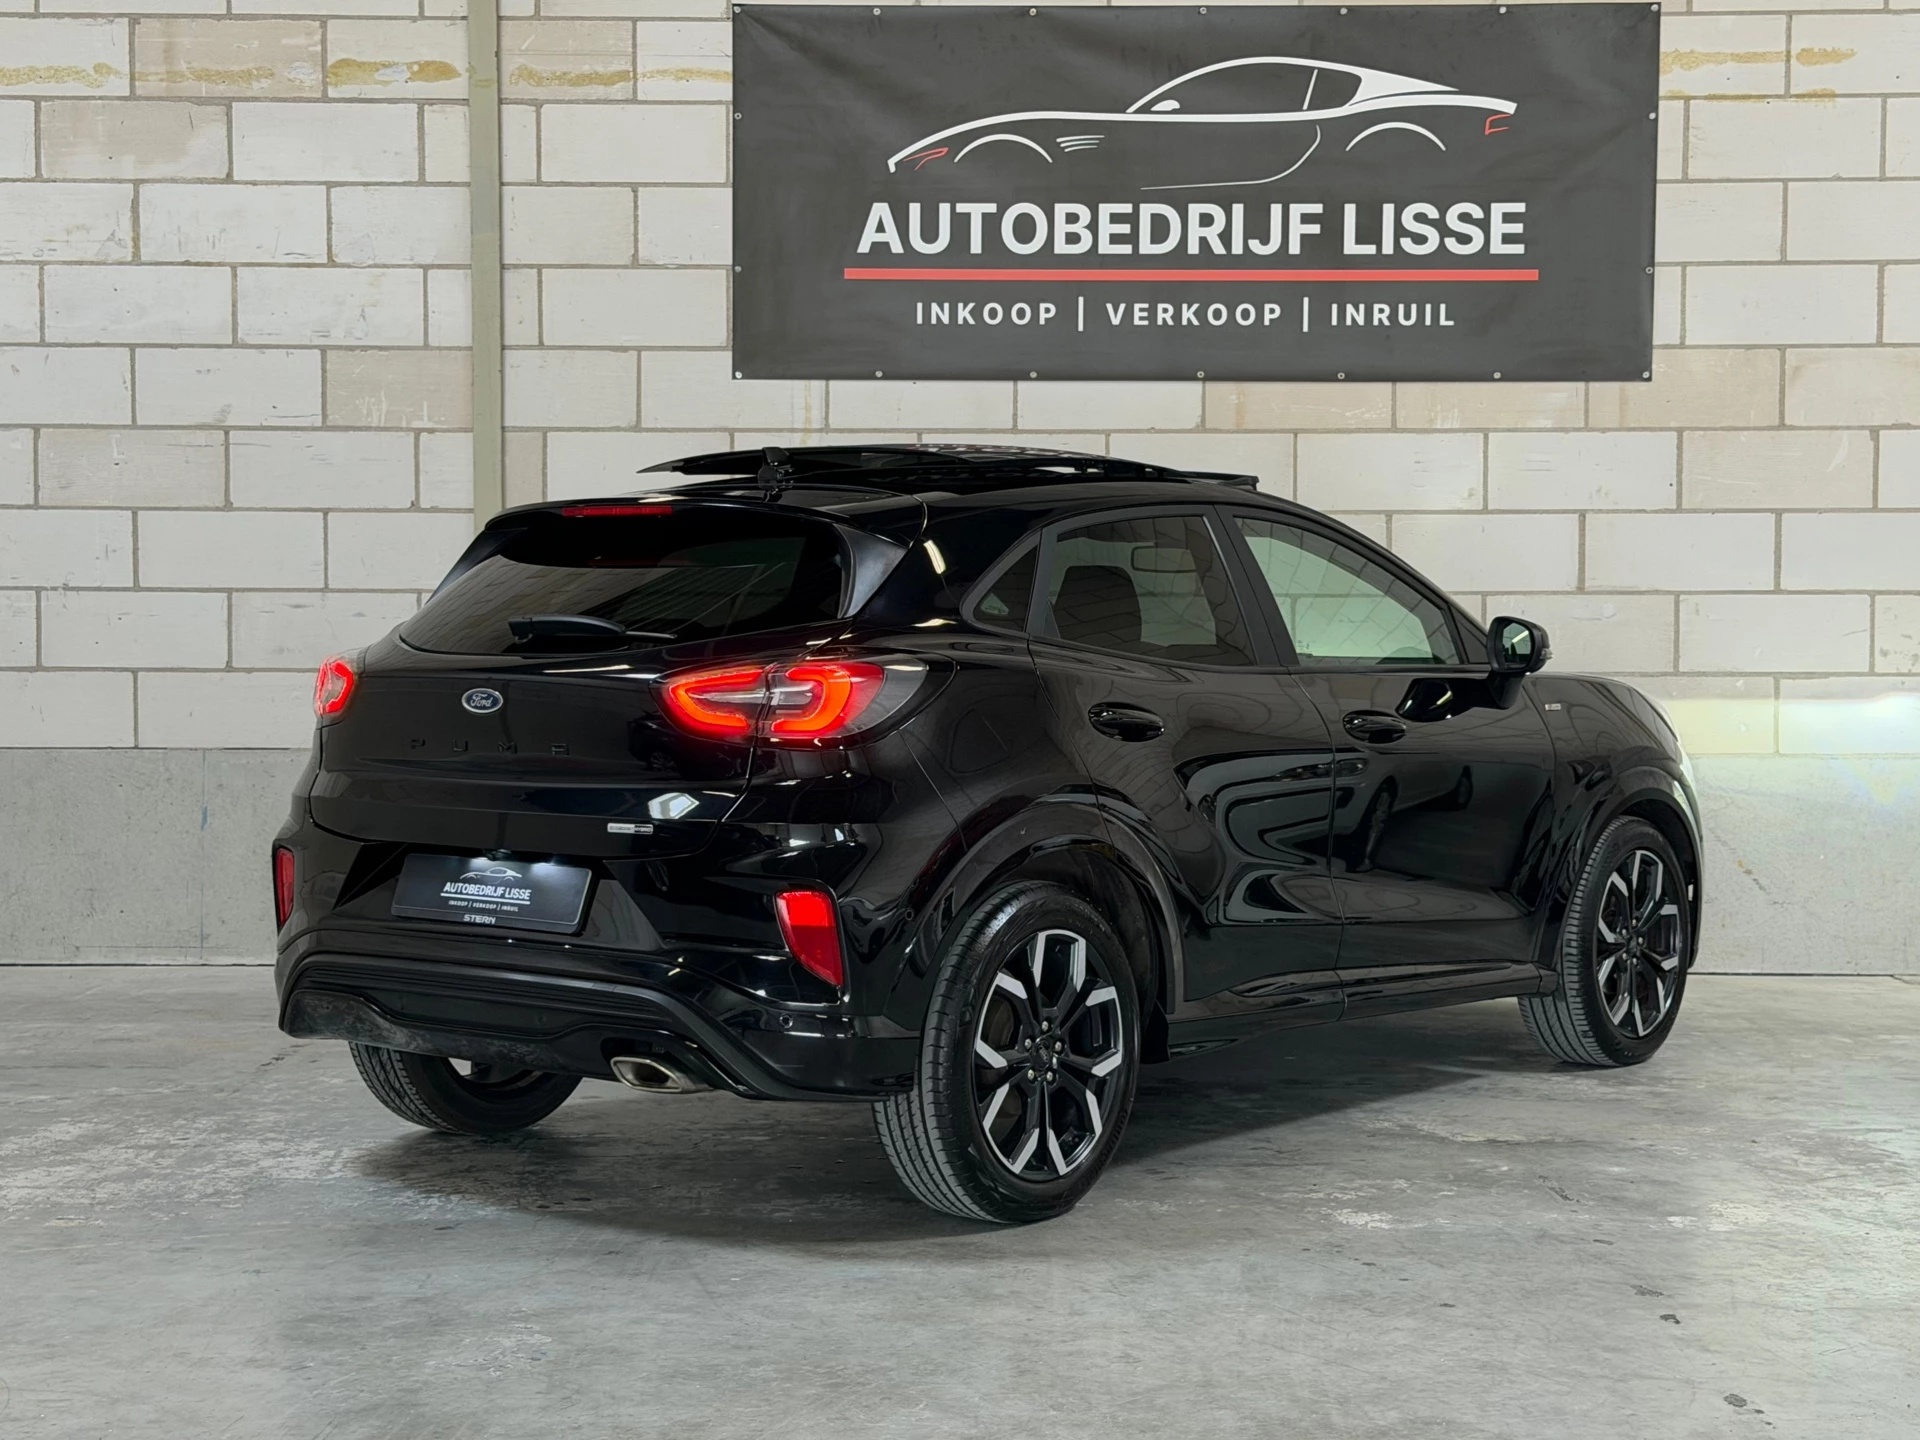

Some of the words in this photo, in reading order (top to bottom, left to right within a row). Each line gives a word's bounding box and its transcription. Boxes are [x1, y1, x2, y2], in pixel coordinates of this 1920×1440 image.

[857, 201, 1323, 257] AUTOBEDRIJF
[1343, 201, 1526, 256] LISSE
[915, 301, 1057, 326] INKOOP
[1105, 301, 1283, 327] VERKOOP
[1329, 302, 1455, 327] INRUIL
[469, 692, 494, 708] Ford
[442, 881, 505, 898] AUTOBEDRIJF
[504, 887, 532, 900] LISSE
[463, 913, 497, 925] STERN
